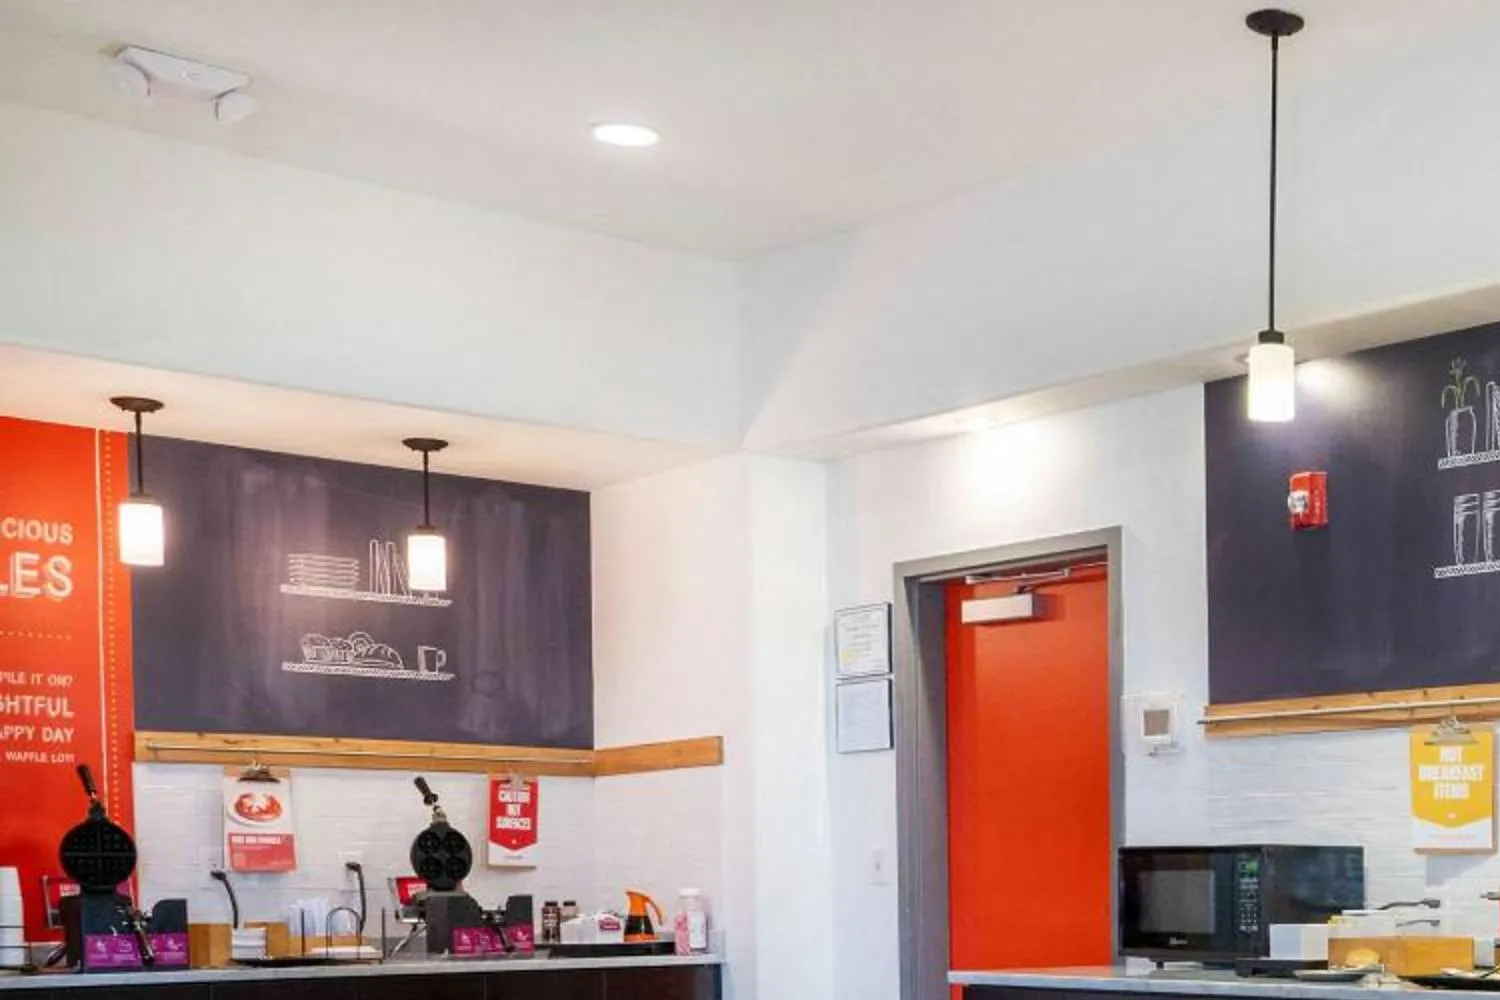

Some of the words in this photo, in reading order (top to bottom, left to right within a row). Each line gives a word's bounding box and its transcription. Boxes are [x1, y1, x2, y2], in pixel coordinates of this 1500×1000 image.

[1, 516, 74, 546] CIOUS
[31, 673, 43, 685] IT
[42, 727, 75, 743] DAY
[5, 751, 47, 764] WAFFLE
